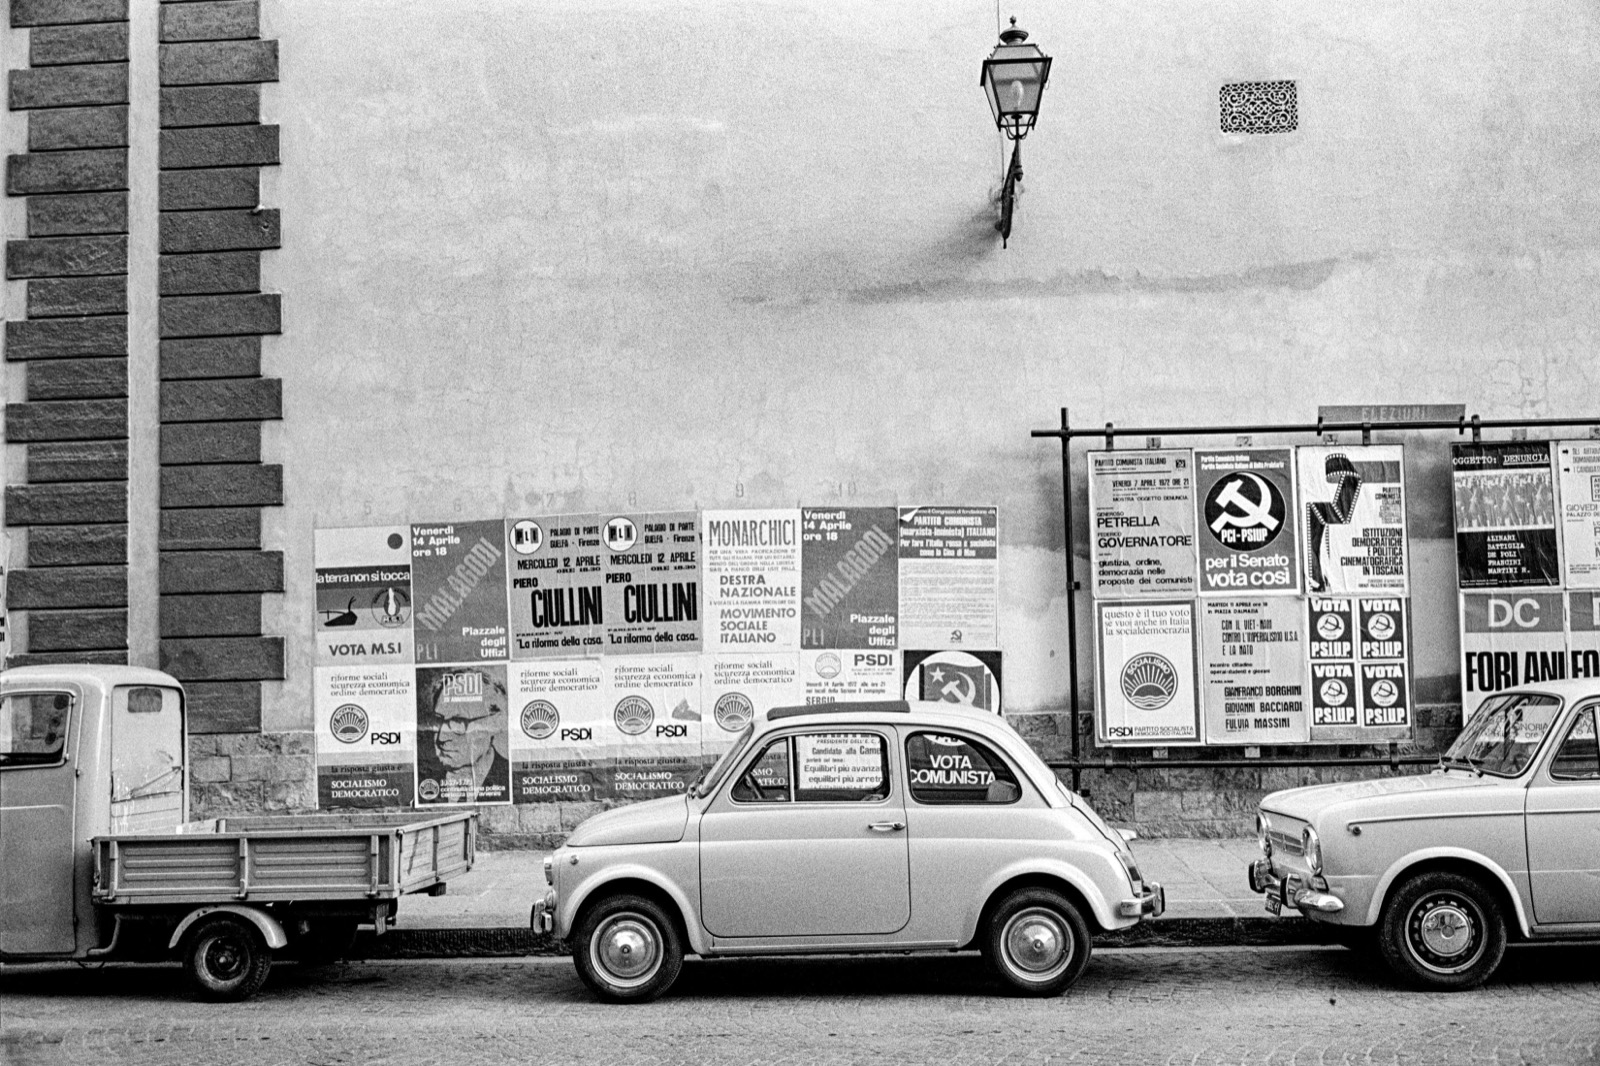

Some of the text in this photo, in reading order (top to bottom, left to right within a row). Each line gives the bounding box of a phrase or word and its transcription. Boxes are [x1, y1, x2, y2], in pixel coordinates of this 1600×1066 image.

[1116, 457, 1166, 466] COMUNISTA ITALIANO
[1452, 454, 1549, 465] OGGETTO: DENUNCIA
[804, 511, 845, 520] Venerdì
[804, 521, 851, 531] 14 Aprile
[944, 516, 982, 526] COMUNISTA
[1097, 516, 1160, 528] PETRELLA
[413, 526, 454, 535] Venerdì
[709, 519, 796, 547] MONARCHICI
[967, 527, 995, 536] ITALIANO
[1363, 528, 1403, 537] ISTITUZIONI
[429, 535, 460, 546] Aprile
[803, 532, 838, 541] ore 18
[1098, 535, 1192, 548] GOVERNATORE
[1352, 537, 1403, 547] DEMOCRATICHE
[1488, 542, 1525, 550] BATTIGLIA
[413, 547, 447, 557] ore 18
[1368, 547, 1403, 556] E POLITICA
[518, 555, 600, 570] MERCOLEDI 12 APRILE
[610, 551, 695, 565] MERCOLEDI 12 APRILE
[1099, 559, 1130, 567] giustizia,
[1205, 553, 1289, 571] per il Senato
[1341, 557, 1403, 566] CINEMATOGRAFICA
[804, 524, 894, 618] MALAGODI
[1099, 567, 1165, 576] democrazia nelle
[1363, 566, 1404, 575] IN TOSCANA
[316, 570, 410, 583] la terra non si tocca
[606, 572, 631, 583] PIERO
[720, 575, 766, 585] DESTRA
[1099, 576, 1193, 587] proposte dei comunisti
[1207, 567, 1290, 587] vota così
[416, 536, 501, 630] MALAGODI
[513, 577, 538, 588] PIERO
[720, 586, 796, 598] NAZIONALE
[531, 586, 603, 628] CIULLINI
[624, 582, 697, 623] CIULLINI
[1311, 600, 1350, 612] VOTA
[1361, 600, 1400, 612] VOTA
[720, 608, 796, 619] MOVIMENTO
[850, 613, 895, 623] Piazzale
[1105, 610, 1134, 619] questo
[1488, 598, 1540, 628] DC
[720, 621, 768, 631] SOCIALE
[1134, 618, 1157, 626] anche
[1169, 617, 1190, 625] Italia
[462, 626, 505, 636] Piazzale
[869, 626, 895, 635] degli
[1106, 626, 1190, 635] la socialdemocrazia
[624, 632, 673, 644] riforma della
[720, 632, 776, 644] ITALIANO
[802, 627, 825, 645] PLI
[481, 637, 506, 647] degli
[532, 635, 580, 648] riforma della
[868, 637, 895, 646] Uffizi
[329, 645, 366, 656] VOTA
[417, 644, 438, 660] PLI
[480, 648, 506, 658] Uffizi
[854, 654, 892, 666] PSDI
[1127, 657, 1170, 675] SOCIALISMO
[1314, 665, 1353, 677] VOTA
[331, 672, 388, 682] riforme sociali
[521, 668, 577, 678] riforme sociali
[1364, 666, 1403, 678] VOTA
[331, 680, 410, 689] sicurezza economica
[443, 672, 482, 696] PSDI
[558, 676, 600, 684] economica
[359, 688, 407, 696] democratico
[520, 685, 547, 693] ordine
[1224, 685, 1301, 697] GIANFRANCO BORGHINI
[1225, 701, 1302, 713] GIOVANNI BACCIARDI
[1226, 718, 1290, 729] FULVIA MASSINI
[561, 728, 592, 741] PSDI
[656, 725, 687, 737] PSDI
[1109, 727, 1133, 737] PSDI
[371, 732, 400, 745] PSDI
[930, 755, 972, 769] VOTA
[804, 765, 849, 773] Equilibri più
[522, 775, 577, 785] SOCIALISMO
[615, 772, 672, 781] SOCIALISMO
[842, 775, 854, 783] più
[910, 769, 996, 785] COMUNISTA
[331, 780, 387, 788] SOCIALISMO
[615, 782, 684, 791] DEMOCRATICO
[331, 789, 399, 798] DEMOCRATICO
[522, 785, 590, 794] DEMOCRATICO
